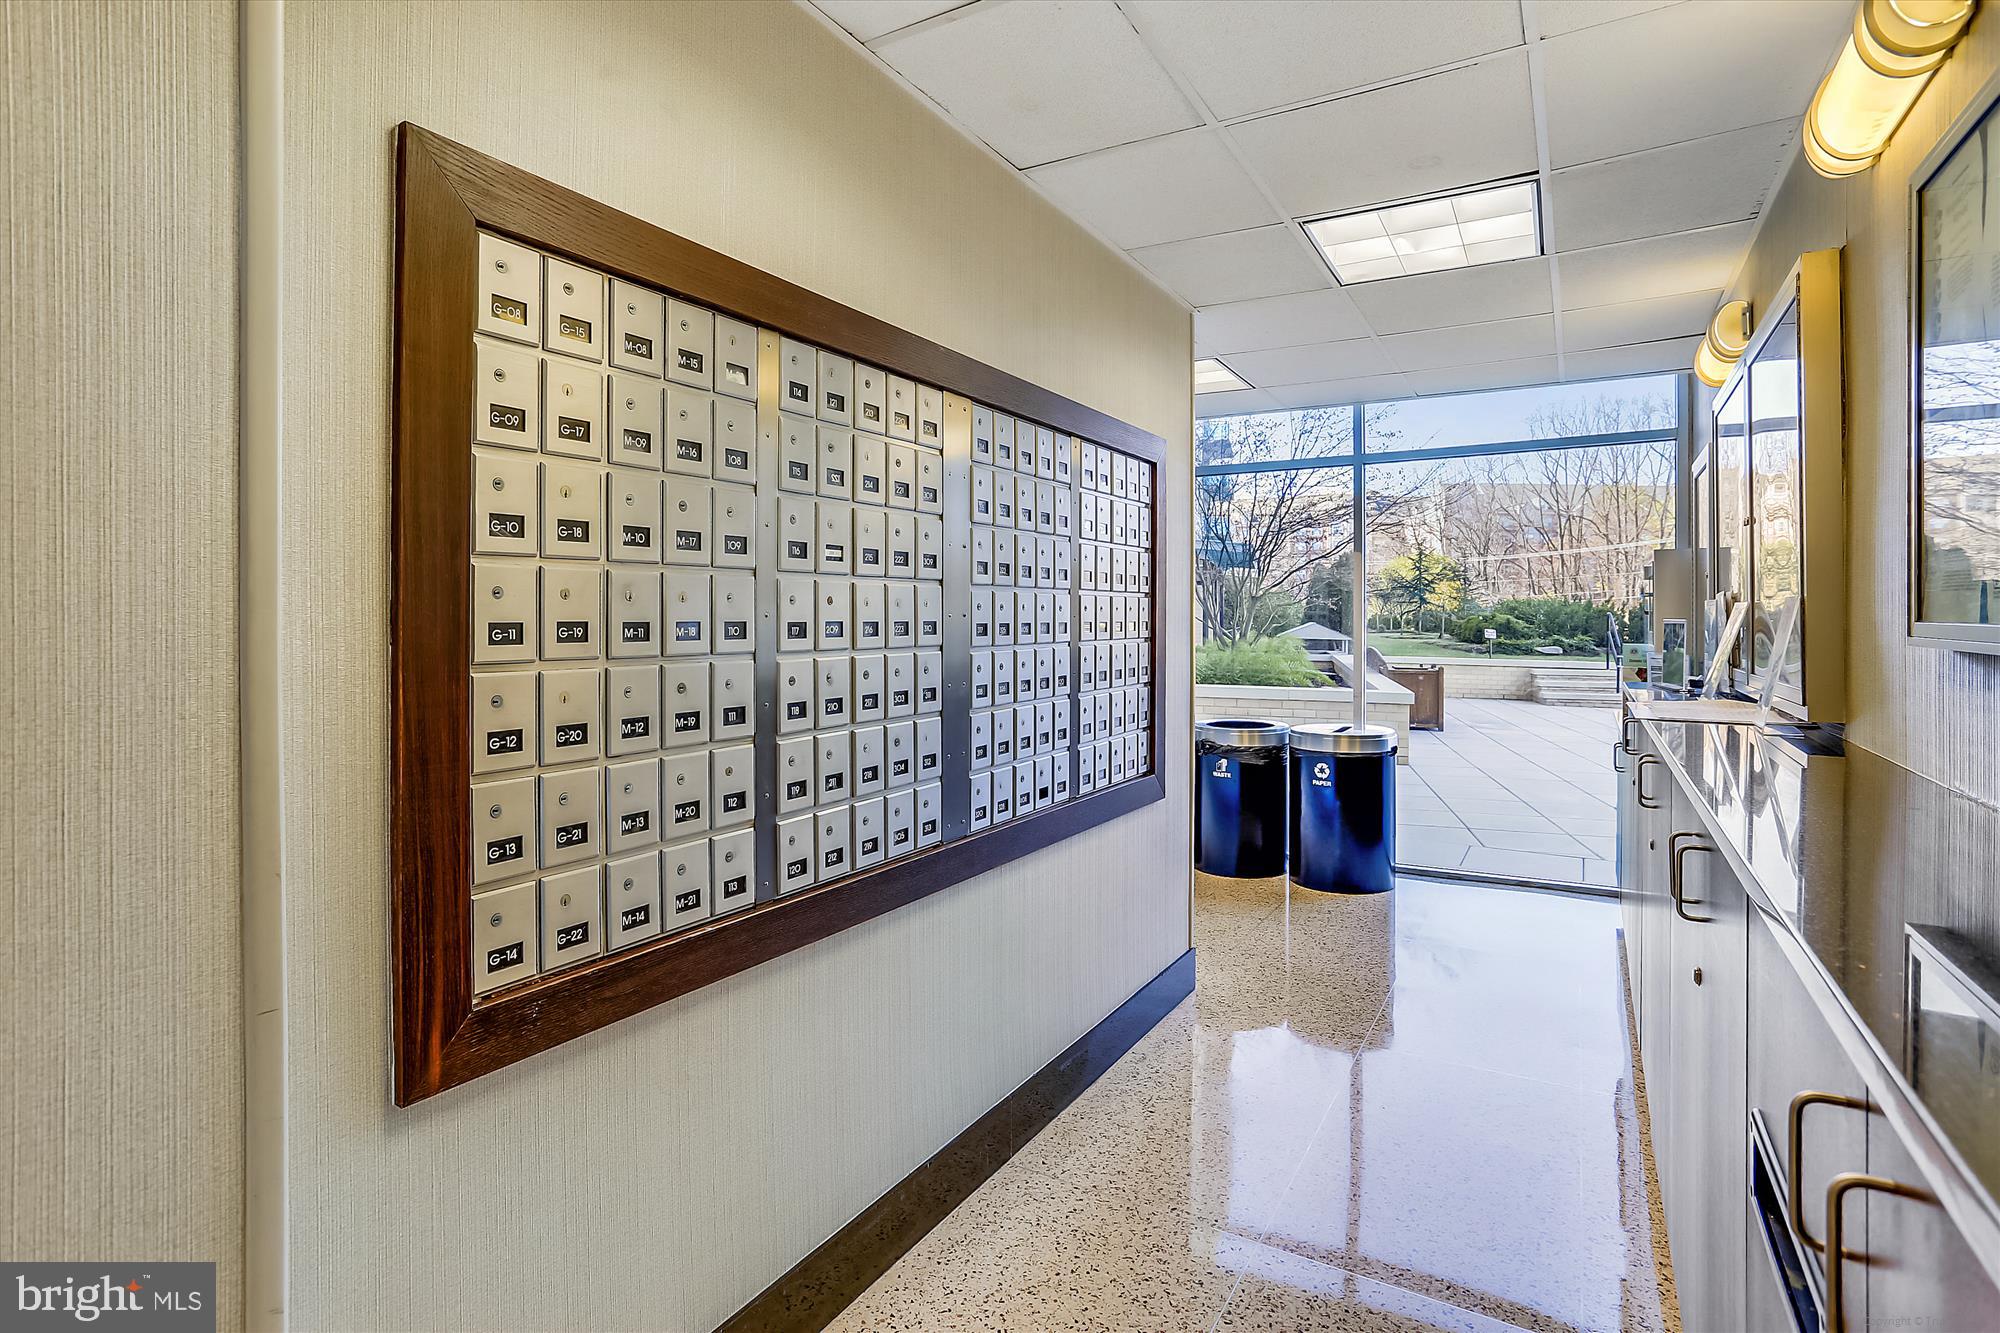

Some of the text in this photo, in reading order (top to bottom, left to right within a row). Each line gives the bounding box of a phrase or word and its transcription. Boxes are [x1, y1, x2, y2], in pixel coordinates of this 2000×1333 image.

[492, 302, 521, 319] G-08
[561, 323, 585, 338] G-15
[625, 339, 646, 355] M-08
[678, 355, 699, 369] M-15
[793, 388, 801, 398] 114
[491, 412, 519, 426] G-09
[865, 408, 874, 418] 213
[560, 424, 584, 438] G-17
[624, 435, 646, 449] M-09
[677, 446, 697, 458] M-16
[727, 455, 741, 466] 108
[491, 520, 518, 534] G-10
[558, 526, 582, 537] G-18
[623, 531, 645, 544] M-10
[677, 536, 696, 547] M-17
[727, 541, 741, 550] 109
[923, 557, 933, 566] 309
[492, 629, 515, 640] G-11
[558, 627, 583, 638] G-19
[624, 628, 644, 638] M-11
[676, 627, 696, 637] M-18
[728, 626, 739, 635] 110
[827, 703, 838, 711] 210
[622, 722, 644, 734] M-12
[675, 716, 696, 728] M-19
[557, 729, 582, 742] G-20
[490, 736, 516, 749] G-12
[728, 798, 737, 807] 112
[675, 806, 695, 818] M-20
[622, 817, 645, 831] M-13
[557, 829, 582, 844] G-21
[489, 844, 516, 859] G-13
[828, 853, 837, 862] 212
[789, 864, 800, 875] 120
[728, 882, 737, 892] 113
[676, 895, 697, 909] M-21
[622, 911, 646, 926] M-14
[558, 928, 583, 944] G-22
[489, 950, 518, 966] G-14
